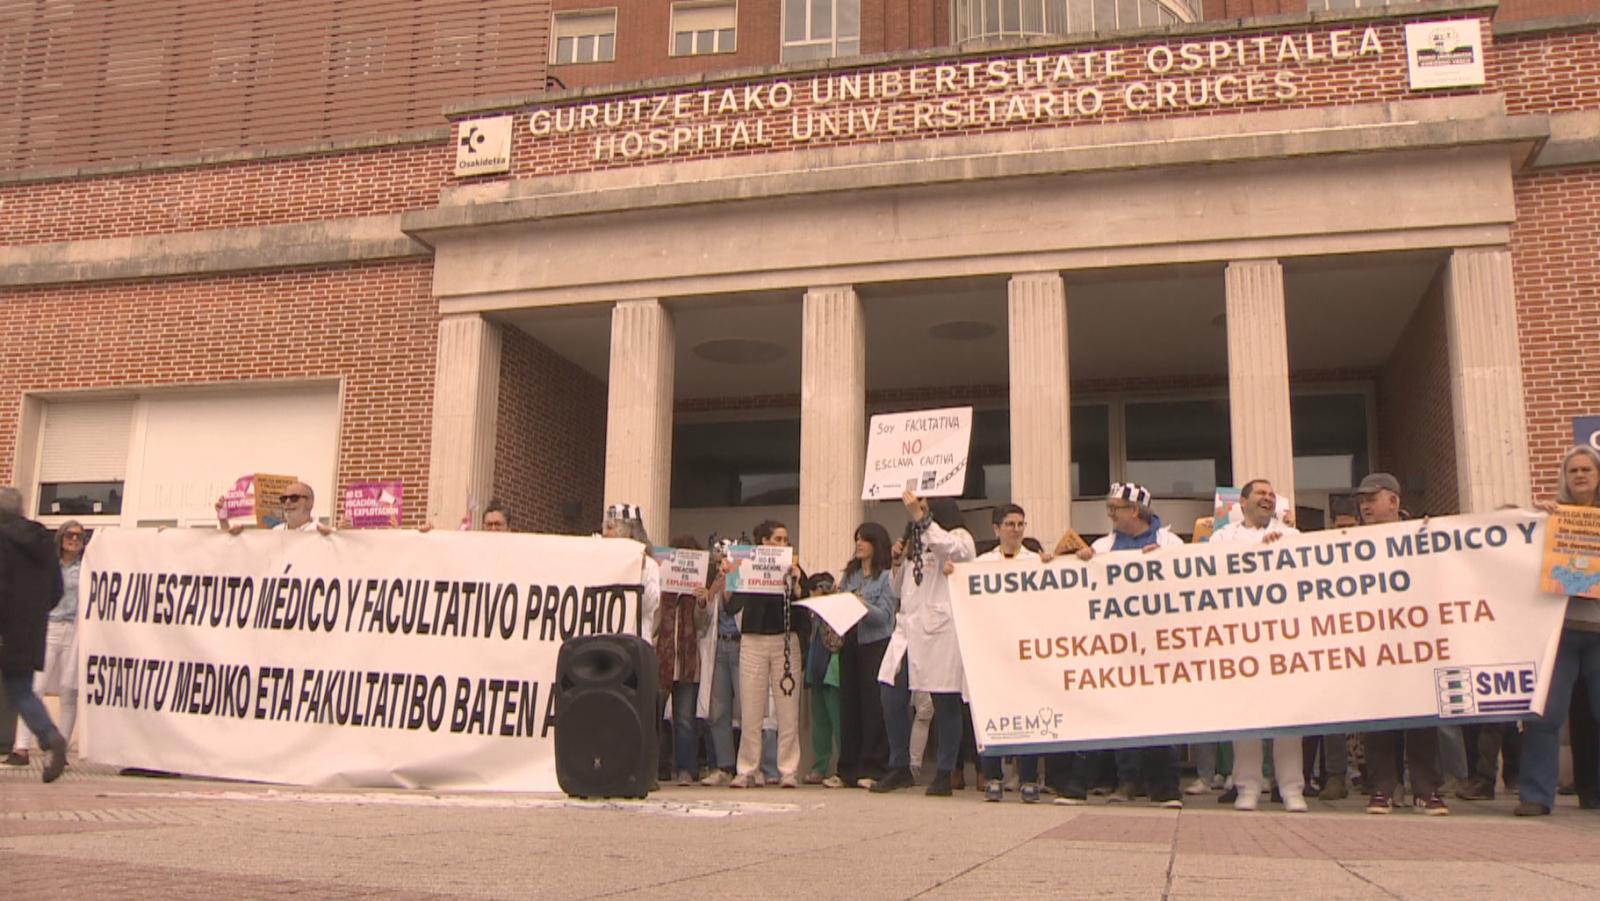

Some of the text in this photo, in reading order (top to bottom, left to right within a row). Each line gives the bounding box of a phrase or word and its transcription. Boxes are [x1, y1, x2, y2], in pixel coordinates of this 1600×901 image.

[529, 27, 1384, 136] GURUTZETAKO UNIBERTSITATE OSPITALEA
[595, 71, 1298, 160] HOSPITAL UNIVERSITARIO CRUCES
[459, 157, 506, 169] Osakidetza
[875, 459, 914, 471] ESCLAVA
[902, 439, 922, 455] NO
[968, 522, 1537, 595] EUSKADI, POR UN ESTATUTO MÉDICO Y
[85, 571, 122, 620] POR
[122, 573, 152, 622] UN
[153, 574, 254, 629] ESTATUTO
[253, 564, 341, 632] MÉDICO
[345, 579, 362, 632] Y
[358, 578, 518, 640] FACULTATIVO
[1089, 569, 1411, 621] FACULTATIVO PROPIO
[1018, 599, 1496, 660] EUSKADI, ESTATUTU MEDIKO ETA
[1063, 638, 1451, 691] FAKULTATIBO BATEN ALDE
[1476, 669, 1535, 695] SME
[87, 655, 173, 711] ESTATUTU
[170, 661, 251, 718] MEDIKO
[254, 666, 294, 722] ETA
[294, 669, 447, 732] FAKULTATIBO
[450, 677, 538, 738] BATEN
